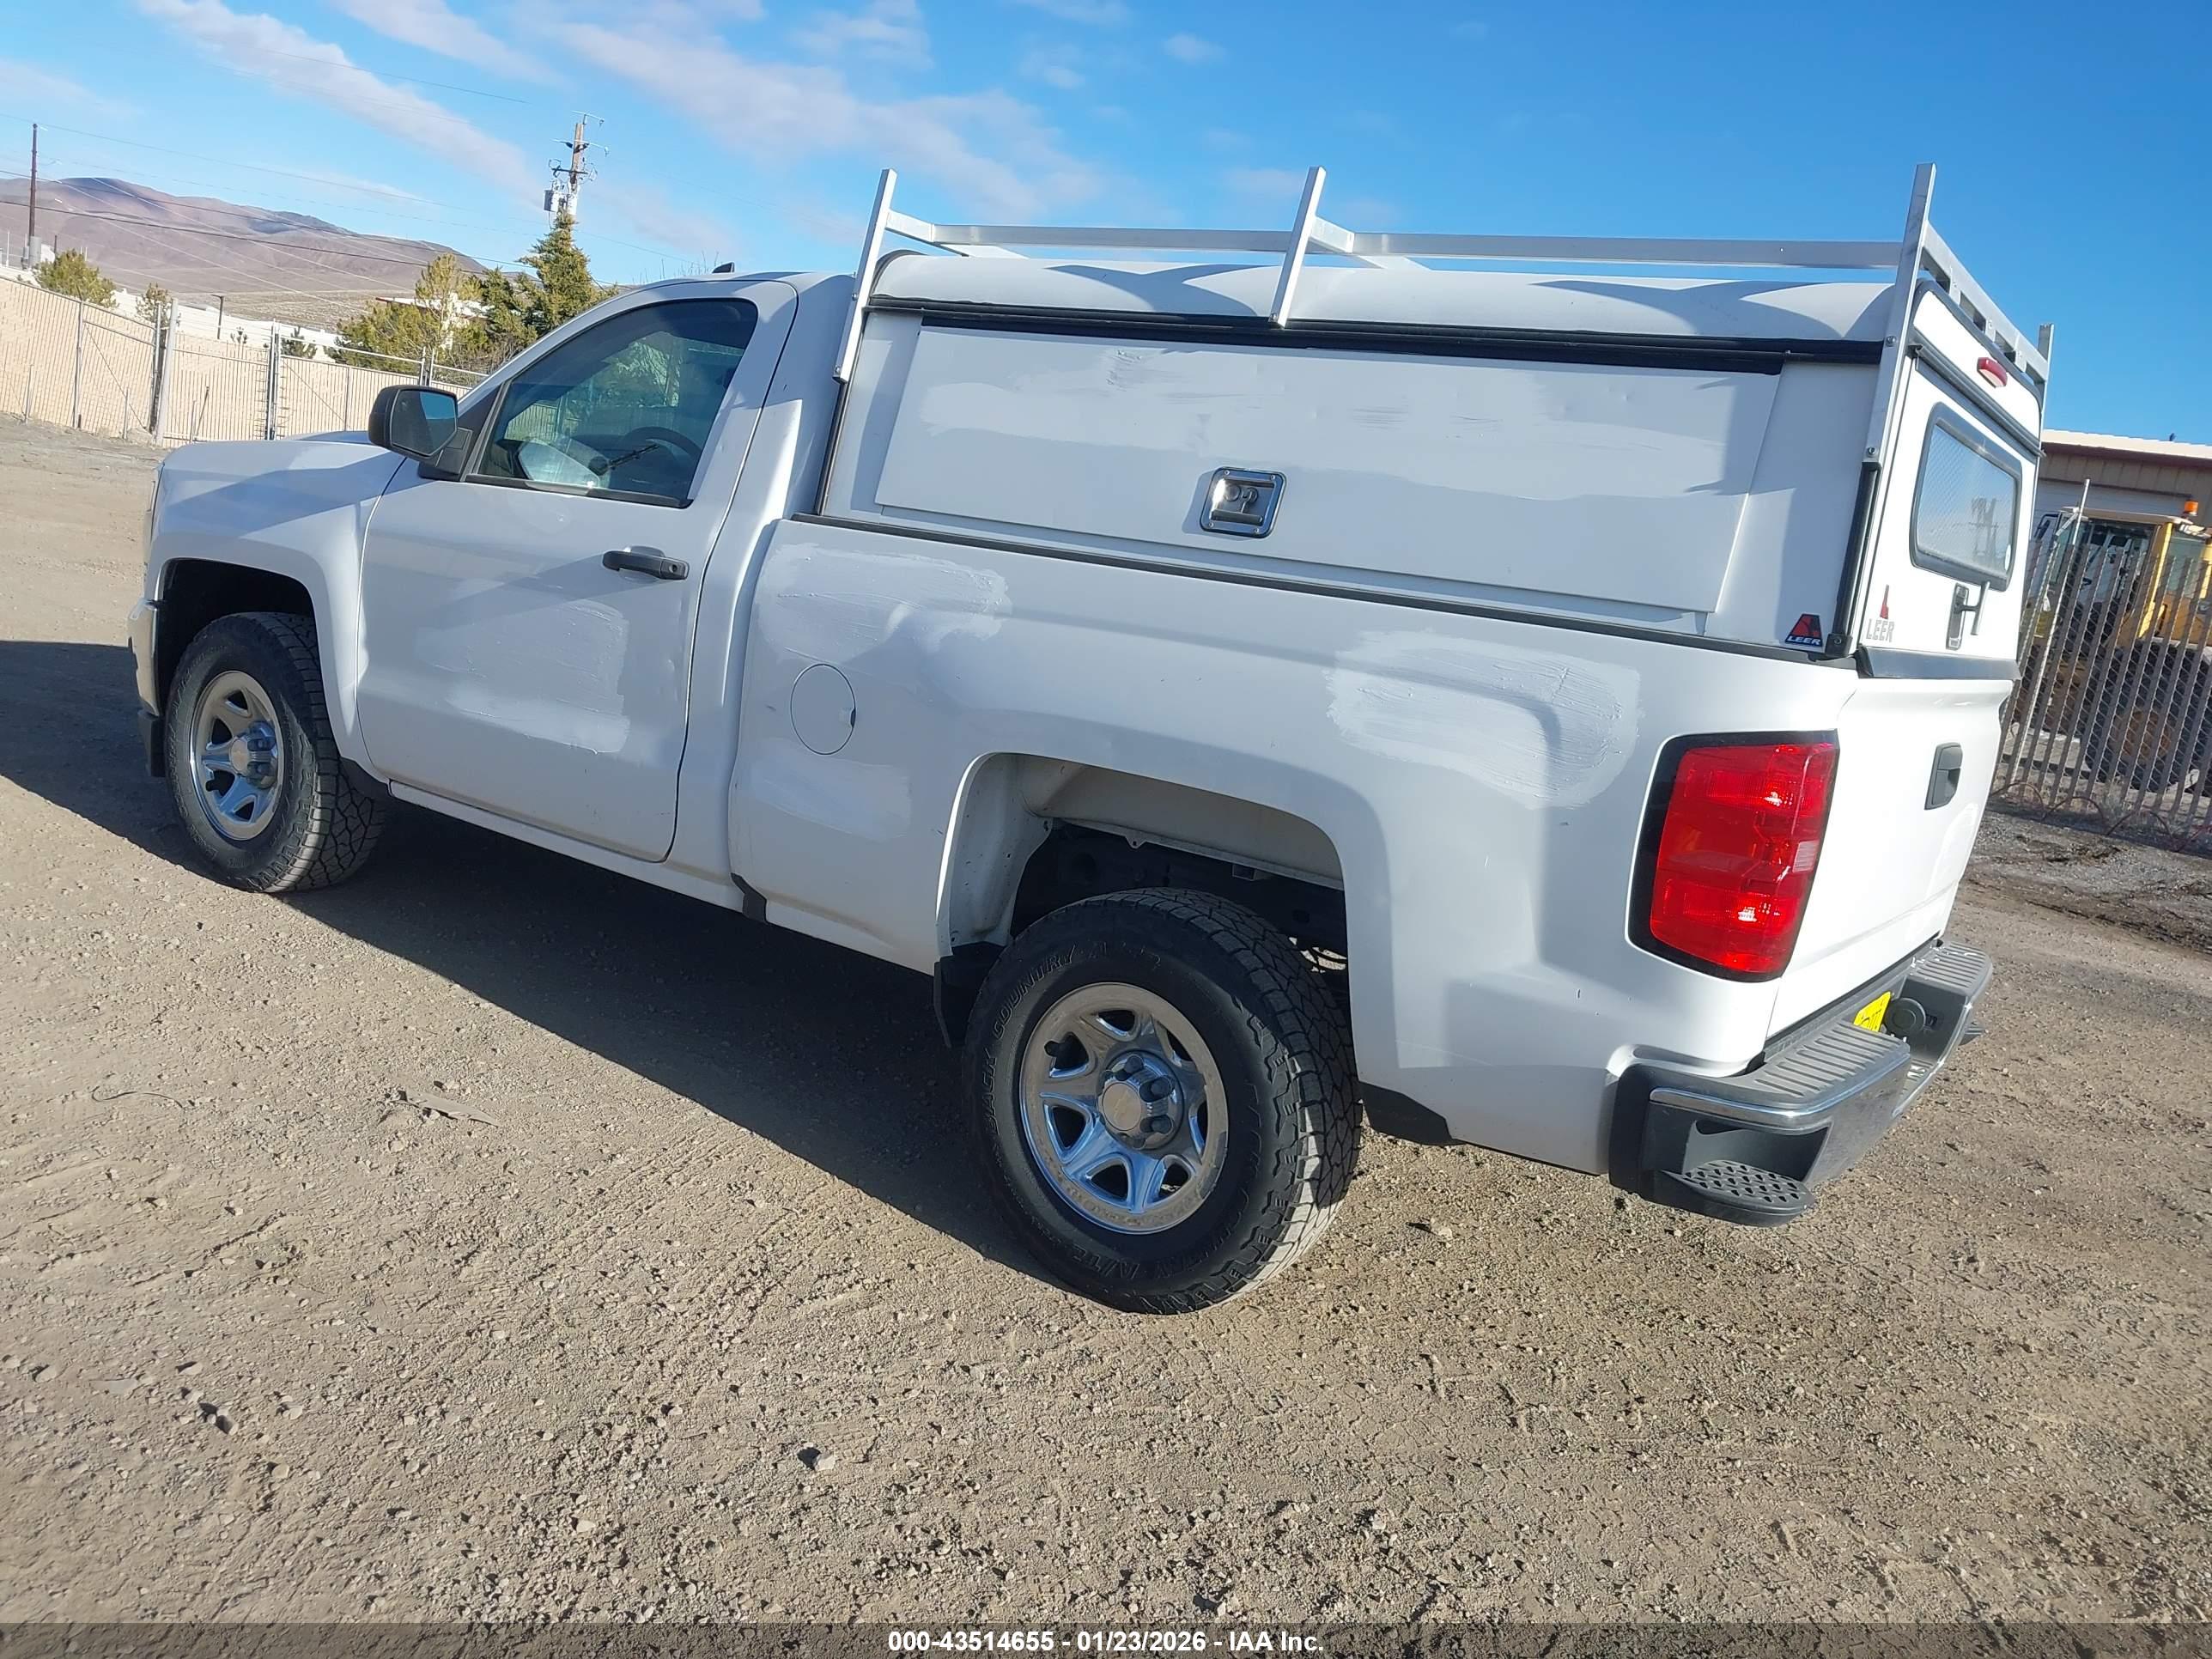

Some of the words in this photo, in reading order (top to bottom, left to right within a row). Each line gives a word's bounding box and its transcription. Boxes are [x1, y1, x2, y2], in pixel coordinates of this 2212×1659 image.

[1787, 636, 1820, 645] LEER
[1865, 618, 1895, 642] LEER
[992, 945, 1076, 1040] COUNTRY
